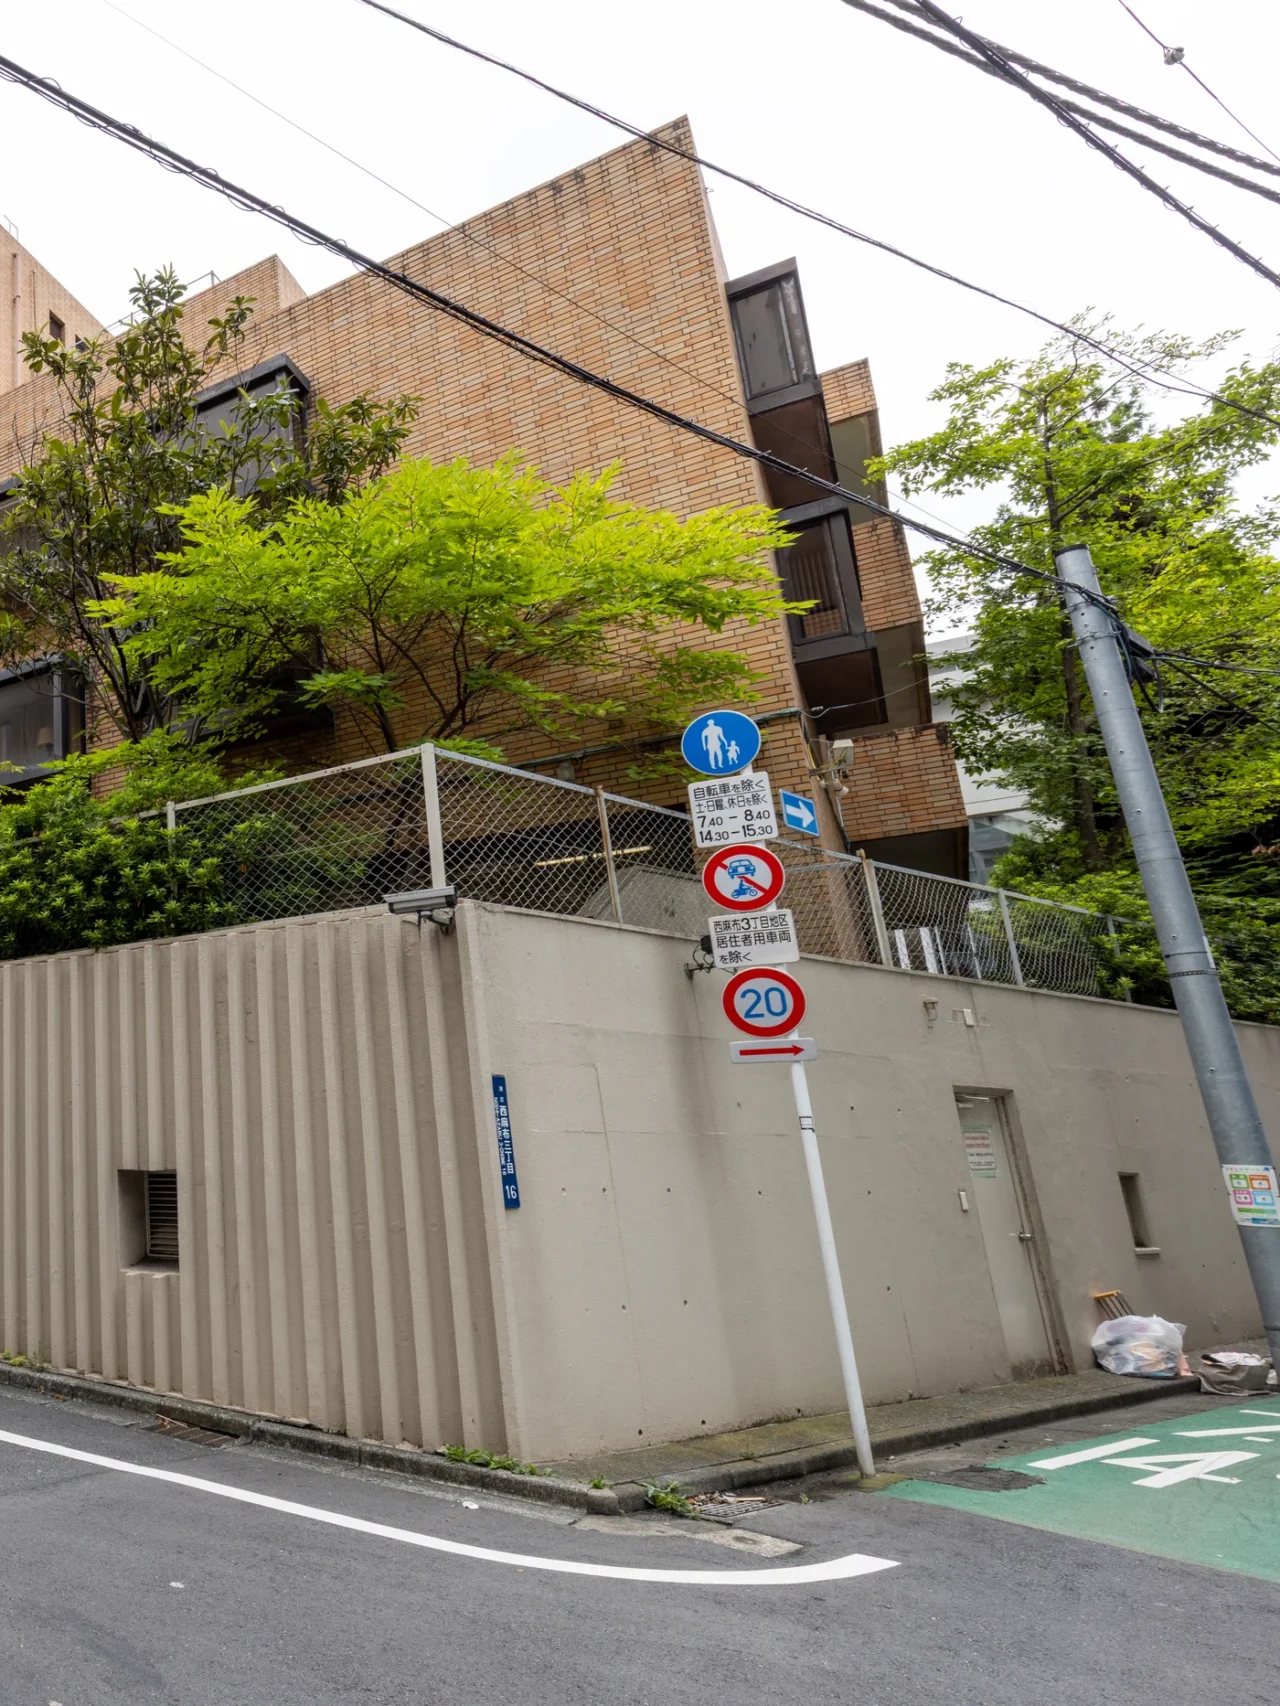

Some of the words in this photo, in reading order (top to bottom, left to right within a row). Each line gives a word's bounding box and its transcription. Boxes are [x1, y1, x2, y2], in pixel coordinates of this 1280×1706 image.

[693, 778, 765, 800] 自転車を除く
[713, 913, 789, 934] 西麻布3丁目地区
[716, 929, 792, 949] 居住者用車両
[719, 950, 753, 965] を除く
[741, 986, 788, 1020] 20
[505, 1185, 517, 1199] 16
